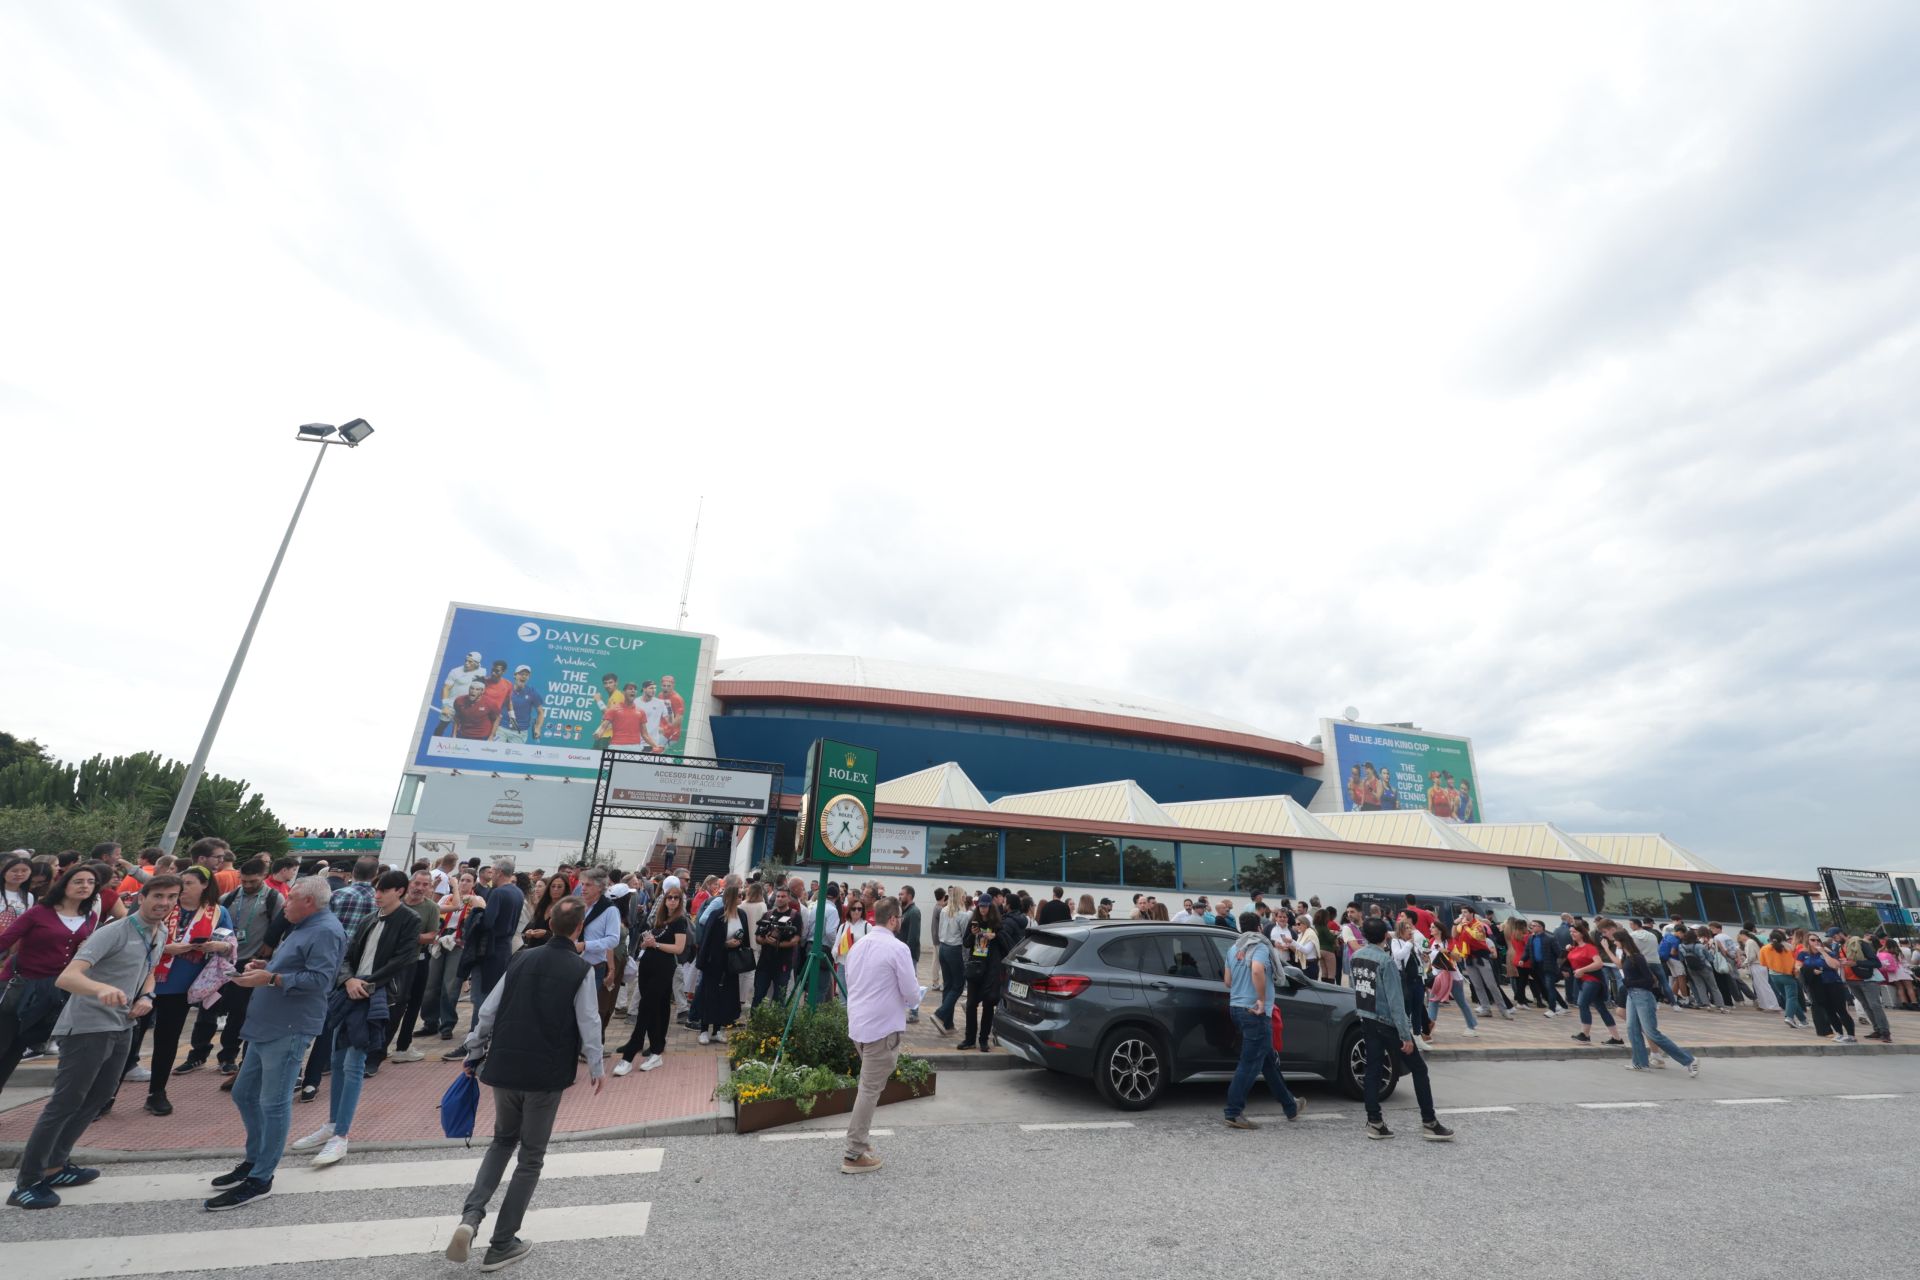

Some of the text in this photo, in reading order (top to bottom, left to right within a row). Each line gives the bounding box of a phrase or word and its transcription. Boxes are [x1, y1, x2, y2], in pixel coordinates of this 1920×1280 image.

[545, 628, 644, 650] DAVIS CUP
[562, 670, 589, 683] THE
[548, 681, 597, 696] WORLD
[545, 694, 595, 709] CUP OF
[542, 706, 593, 722] TENNIS
[1349, 734, 1372, 745] BILLIE
[1374, 736, 1394, 747] JEAN
[1394, 740, 1414, 750] KING
[1415, 742, 1430, 752] CUP
[1400, 763, 1416, 773] THE
[654, 770, 687, 779] ACCESOS
[688, 773, 714, 781] PALCOS
[828, 767, 868, 784] ROLEX
[1396, 772, 1424, 782] WORLD
[1397, 781, 1424, 792] CUP OF
[1398, 791, 1426, 802] TENNIS
